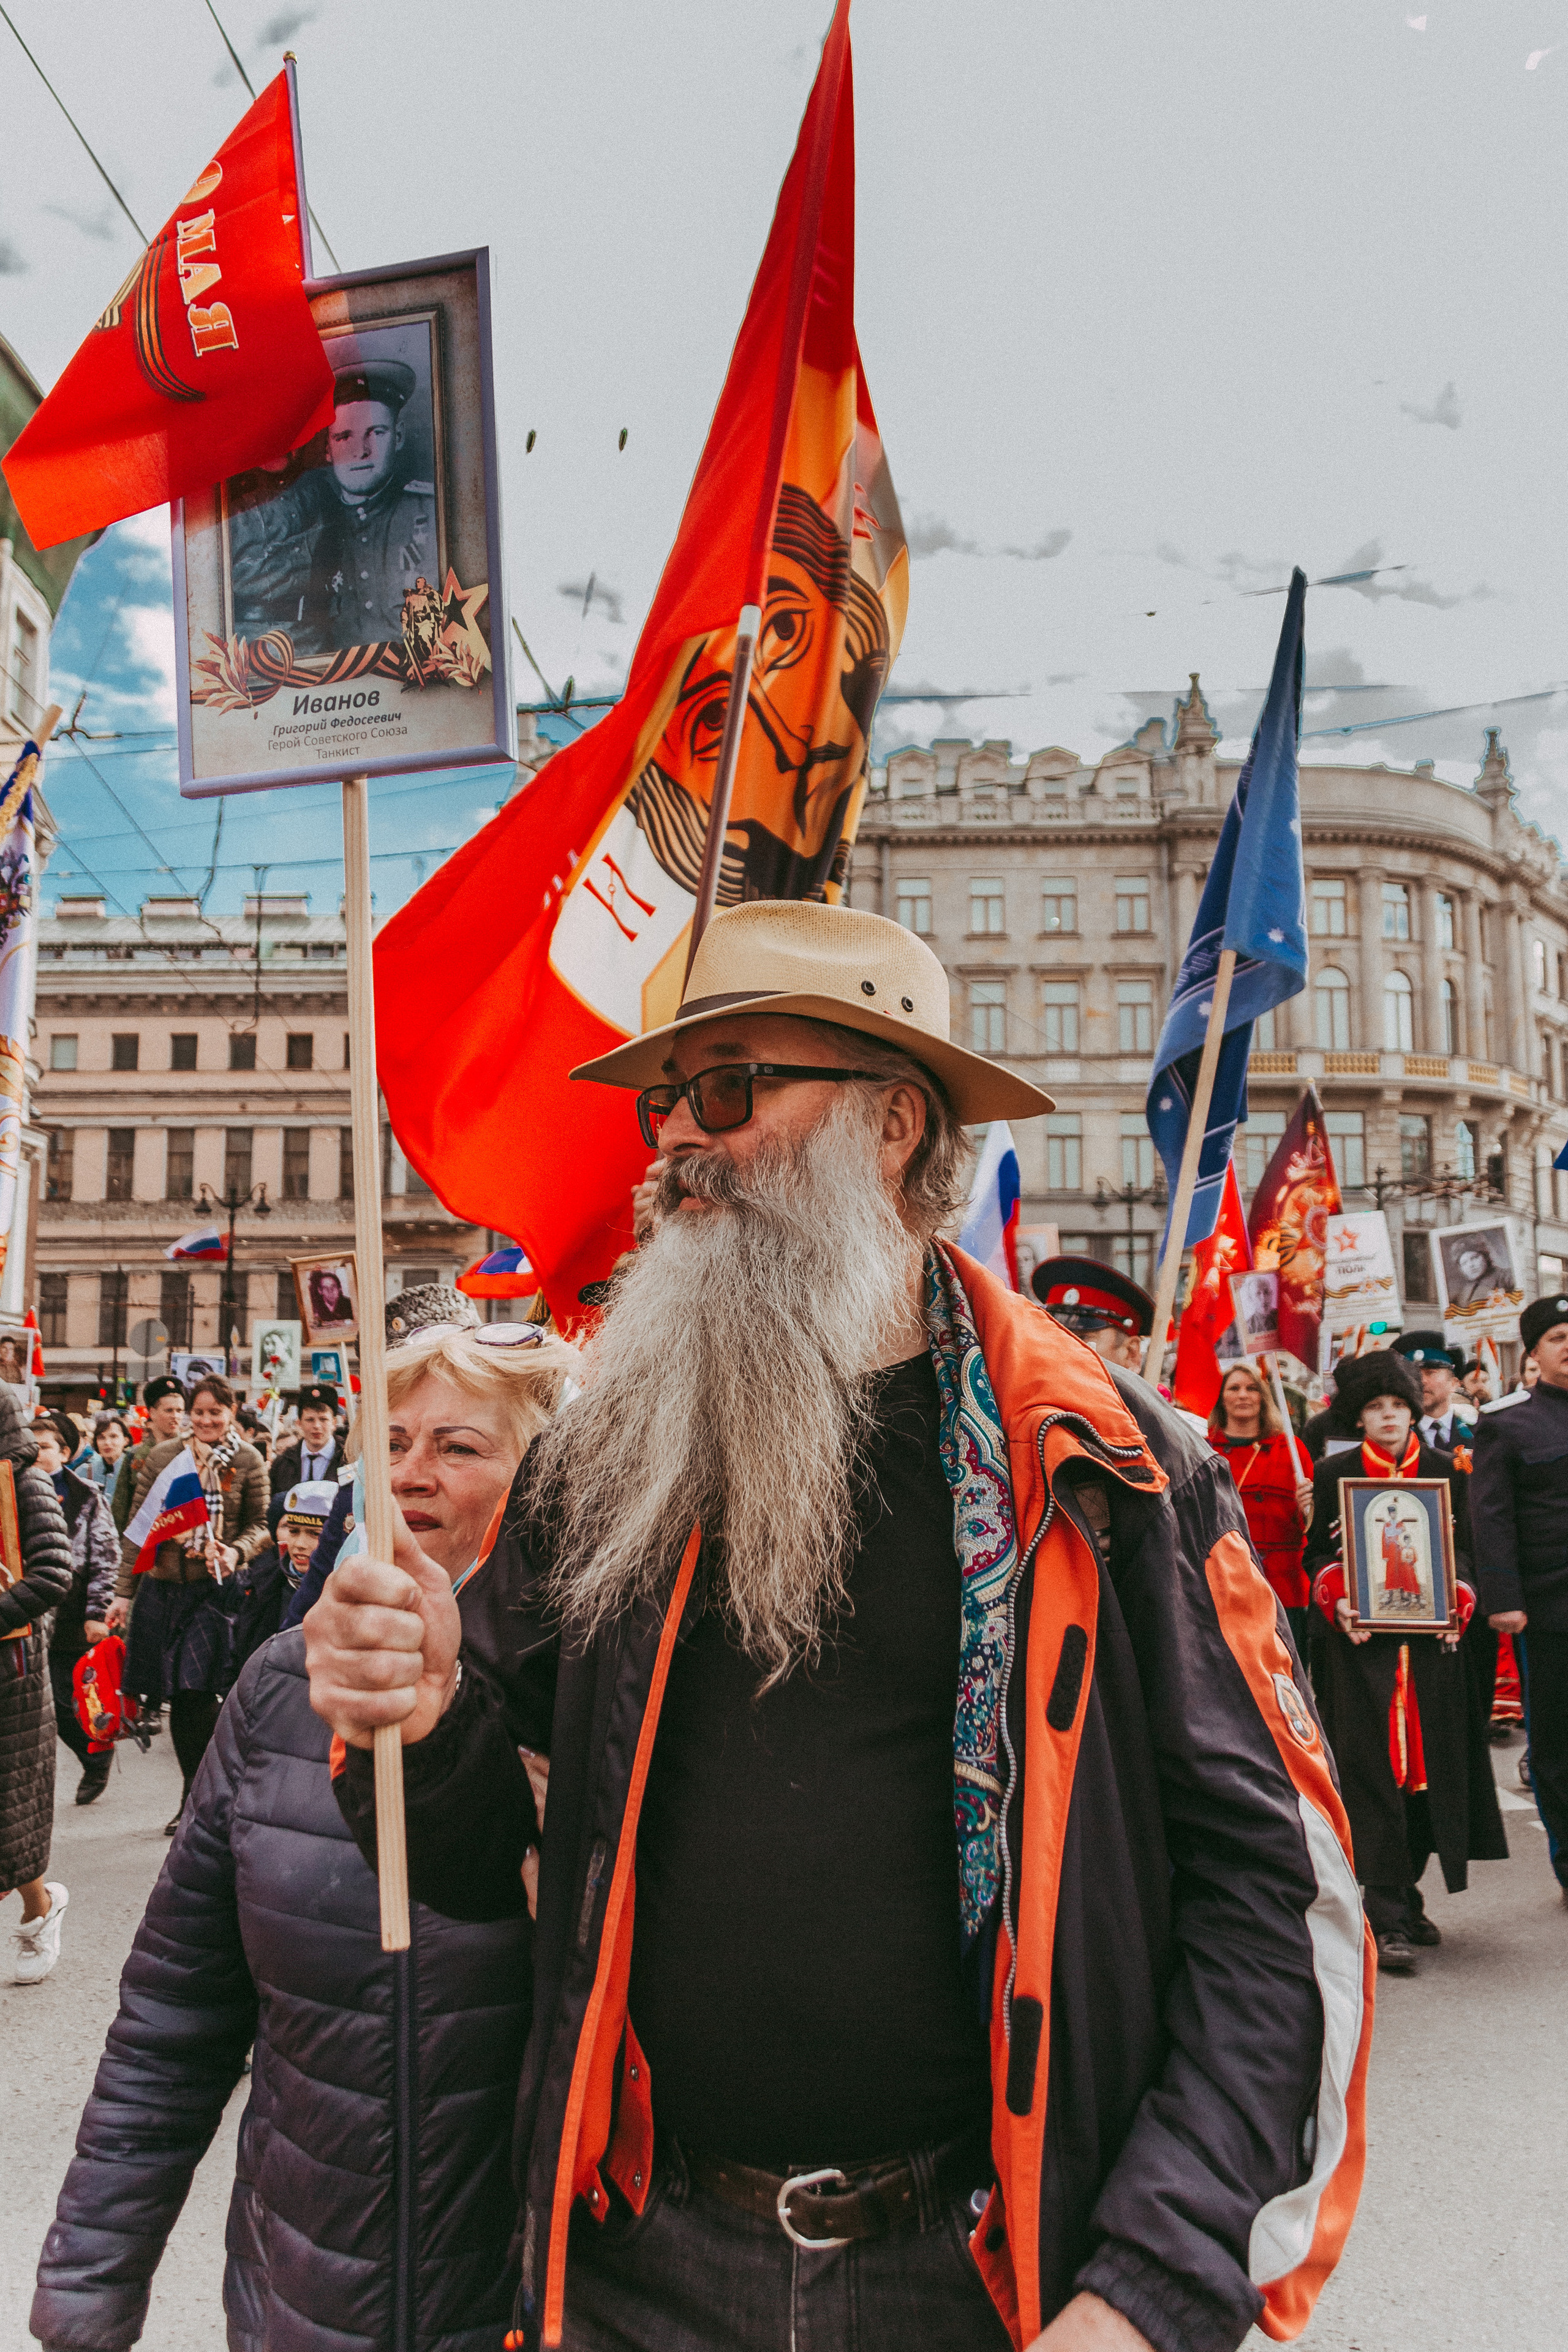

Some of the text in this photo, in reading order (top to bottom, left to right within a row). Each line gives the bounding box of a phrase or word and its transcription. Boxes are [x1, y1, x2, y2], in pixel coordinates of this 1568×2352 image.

[176, 208, 239, 357] МАЯ
[293, 690, 380, 715] Иванов
[273, 712, 401, 737] Григорий Федосеевич
[268, 726, 407, 751] Герой Советского Союза
[316, 746, 360, 759] Танкист
